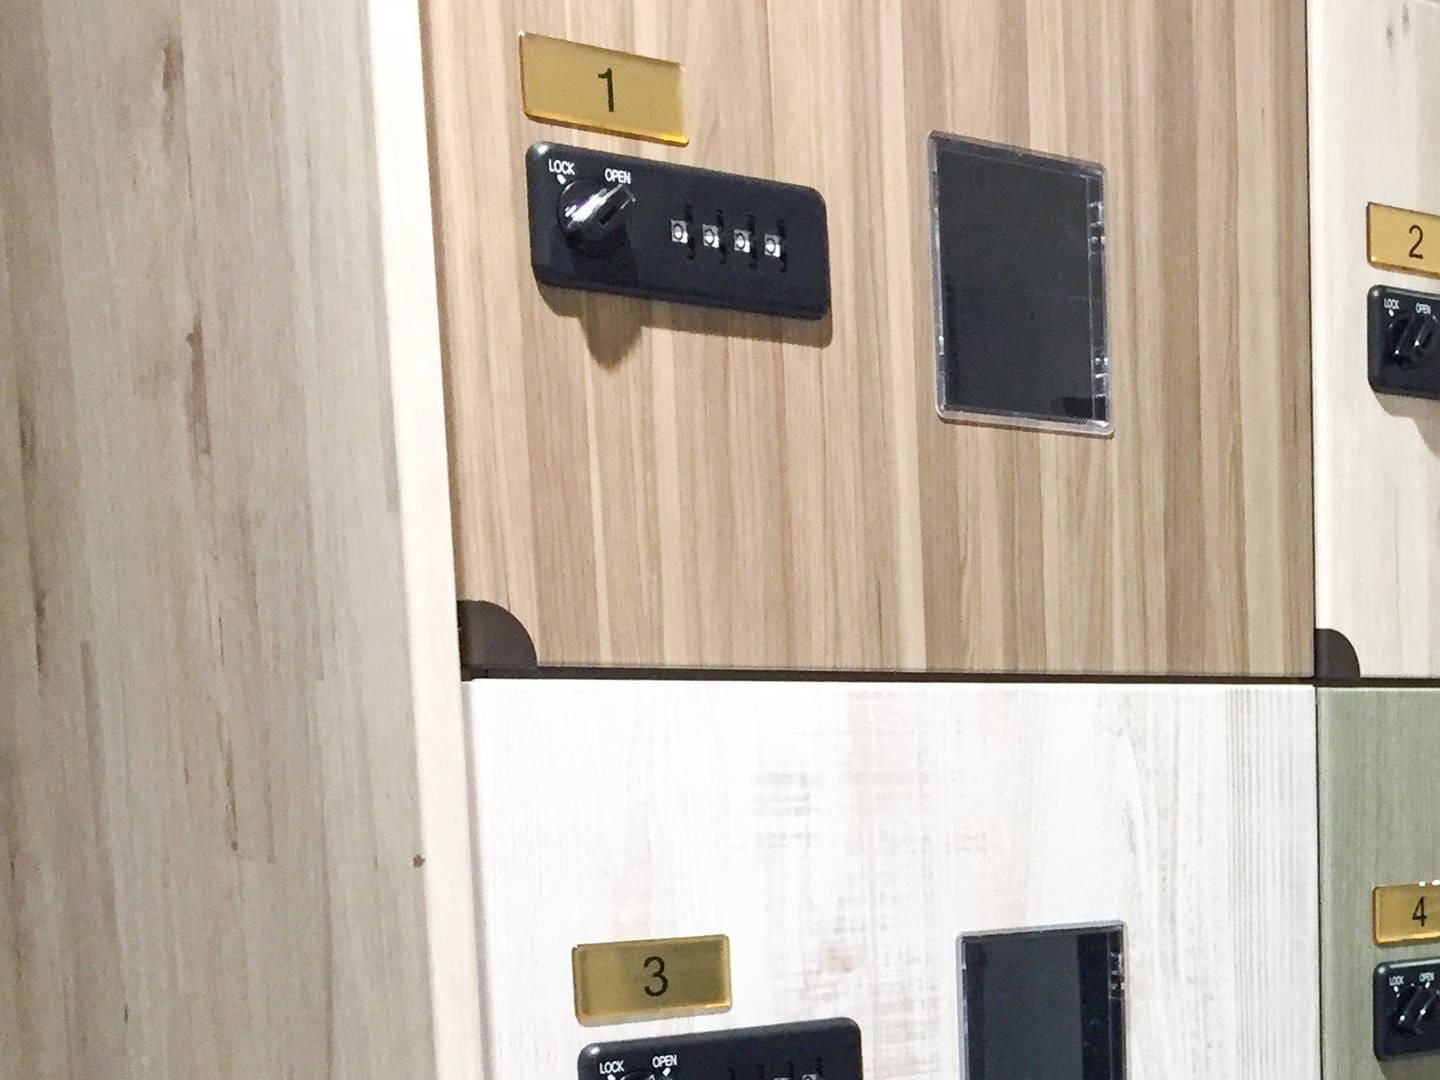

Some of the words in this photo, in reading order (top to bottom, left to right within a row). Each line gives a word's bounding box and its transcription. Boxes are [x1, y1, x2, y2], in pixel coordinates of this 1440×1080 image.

[597, 67, 615, 113] 1
[547, 158, 576, 176] LOCK
[604, 167, 632, 185] OPEN
[1408, 224, 1424, 260] 2
[1383, 298, 1400, 310] LOCK
[1415, 302, 1432, 314] OPEN
[1411, 896, 1428, 927] 4
[643, 956, 669, 997] 3
[599, 1059, 625, 1075] LOCK
[652, 1054, 678, 1068] OPEN
